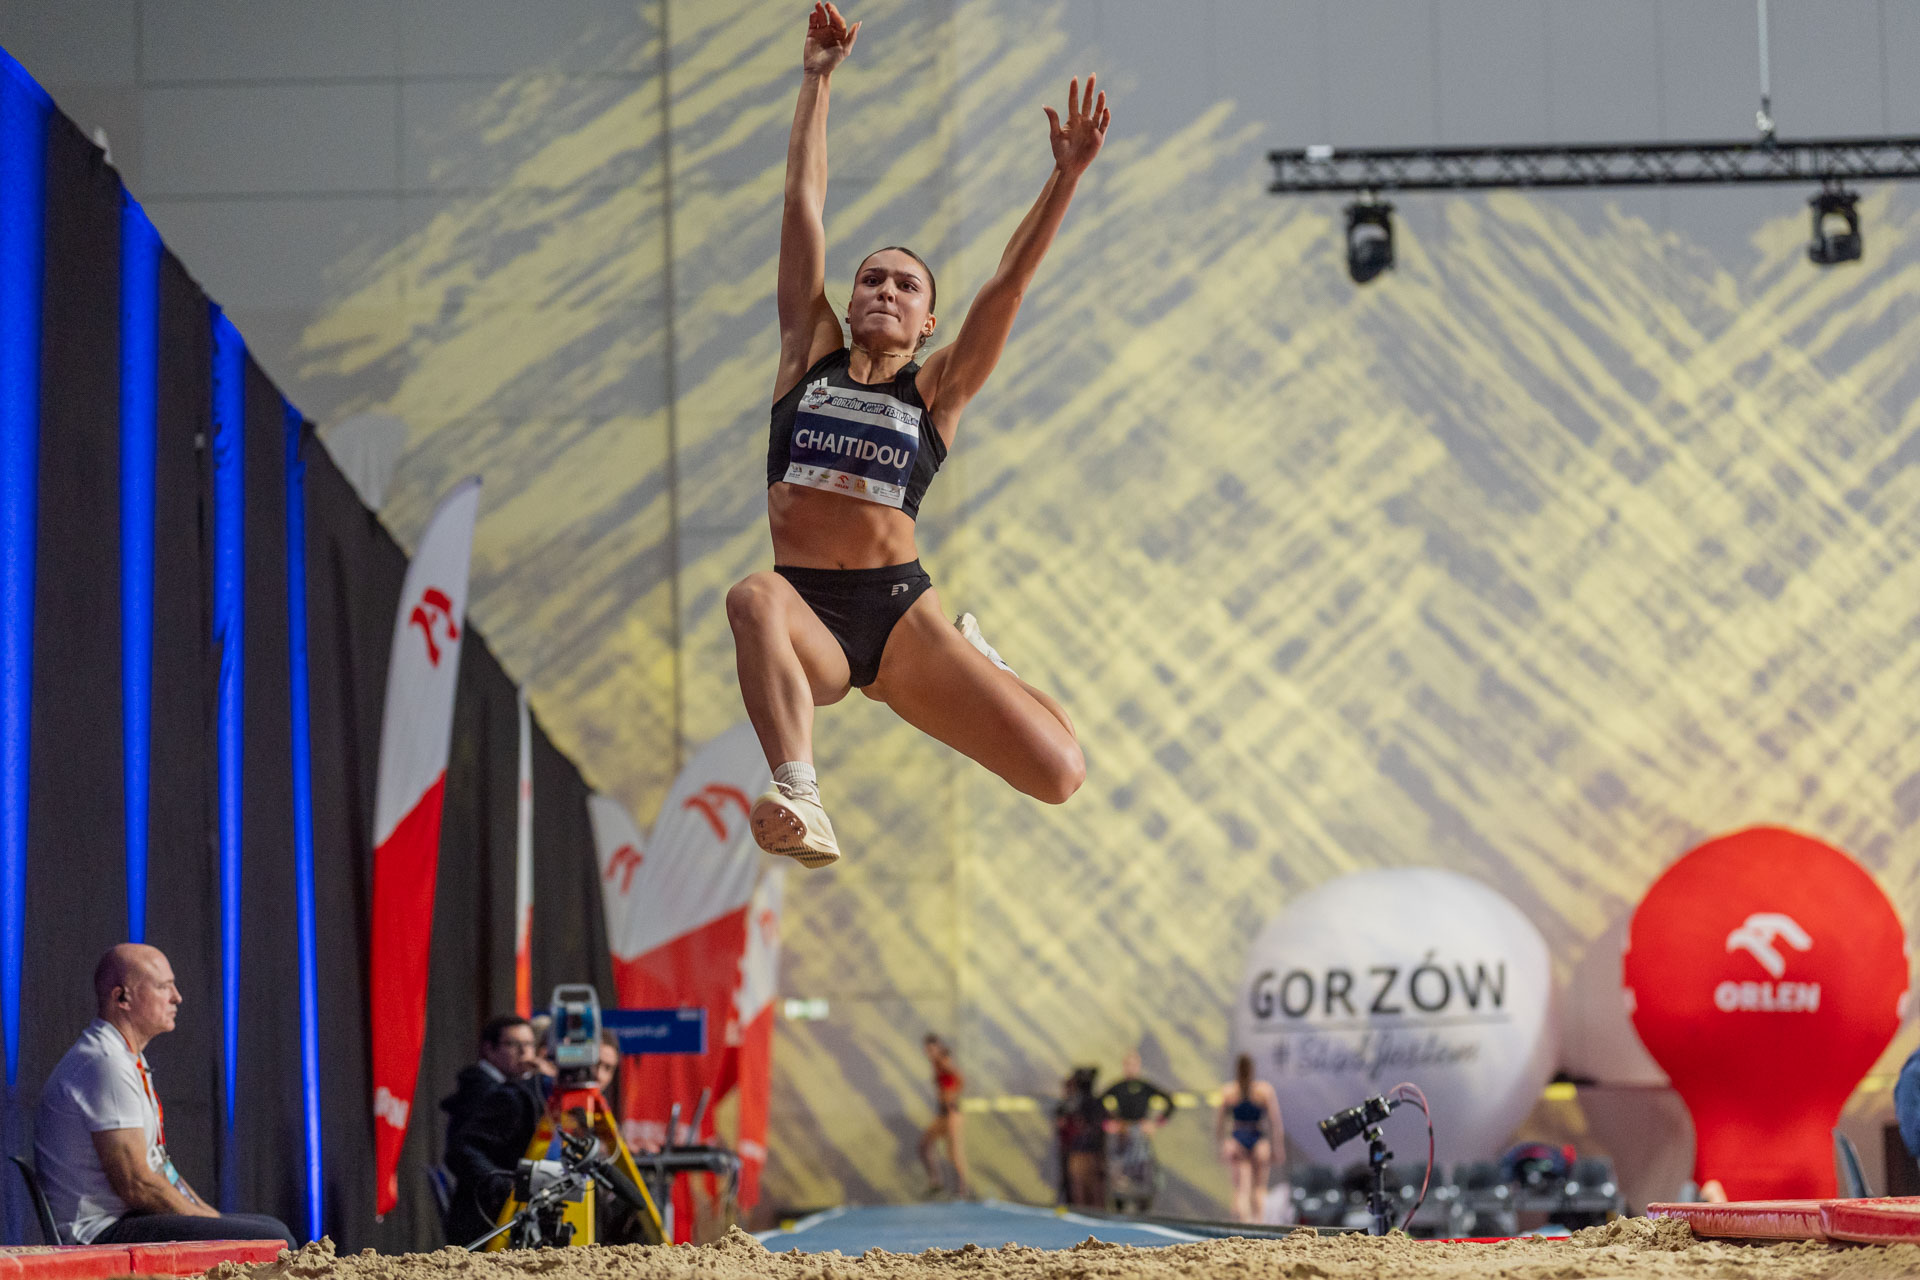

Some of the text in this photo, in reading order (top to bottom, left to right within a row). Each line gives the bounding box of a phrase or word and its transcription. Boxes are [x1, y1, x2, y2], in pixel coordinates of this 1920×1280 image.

[831, 396, 863, 411] GORZÓW
[862, 402, 885, 414] JUMP
[795, 429, 910, 469] CHAITIDOU
[1251, 949, 1506, 1019] GORZÓW
[1714, 981, 1821, 1013] ORLEN
